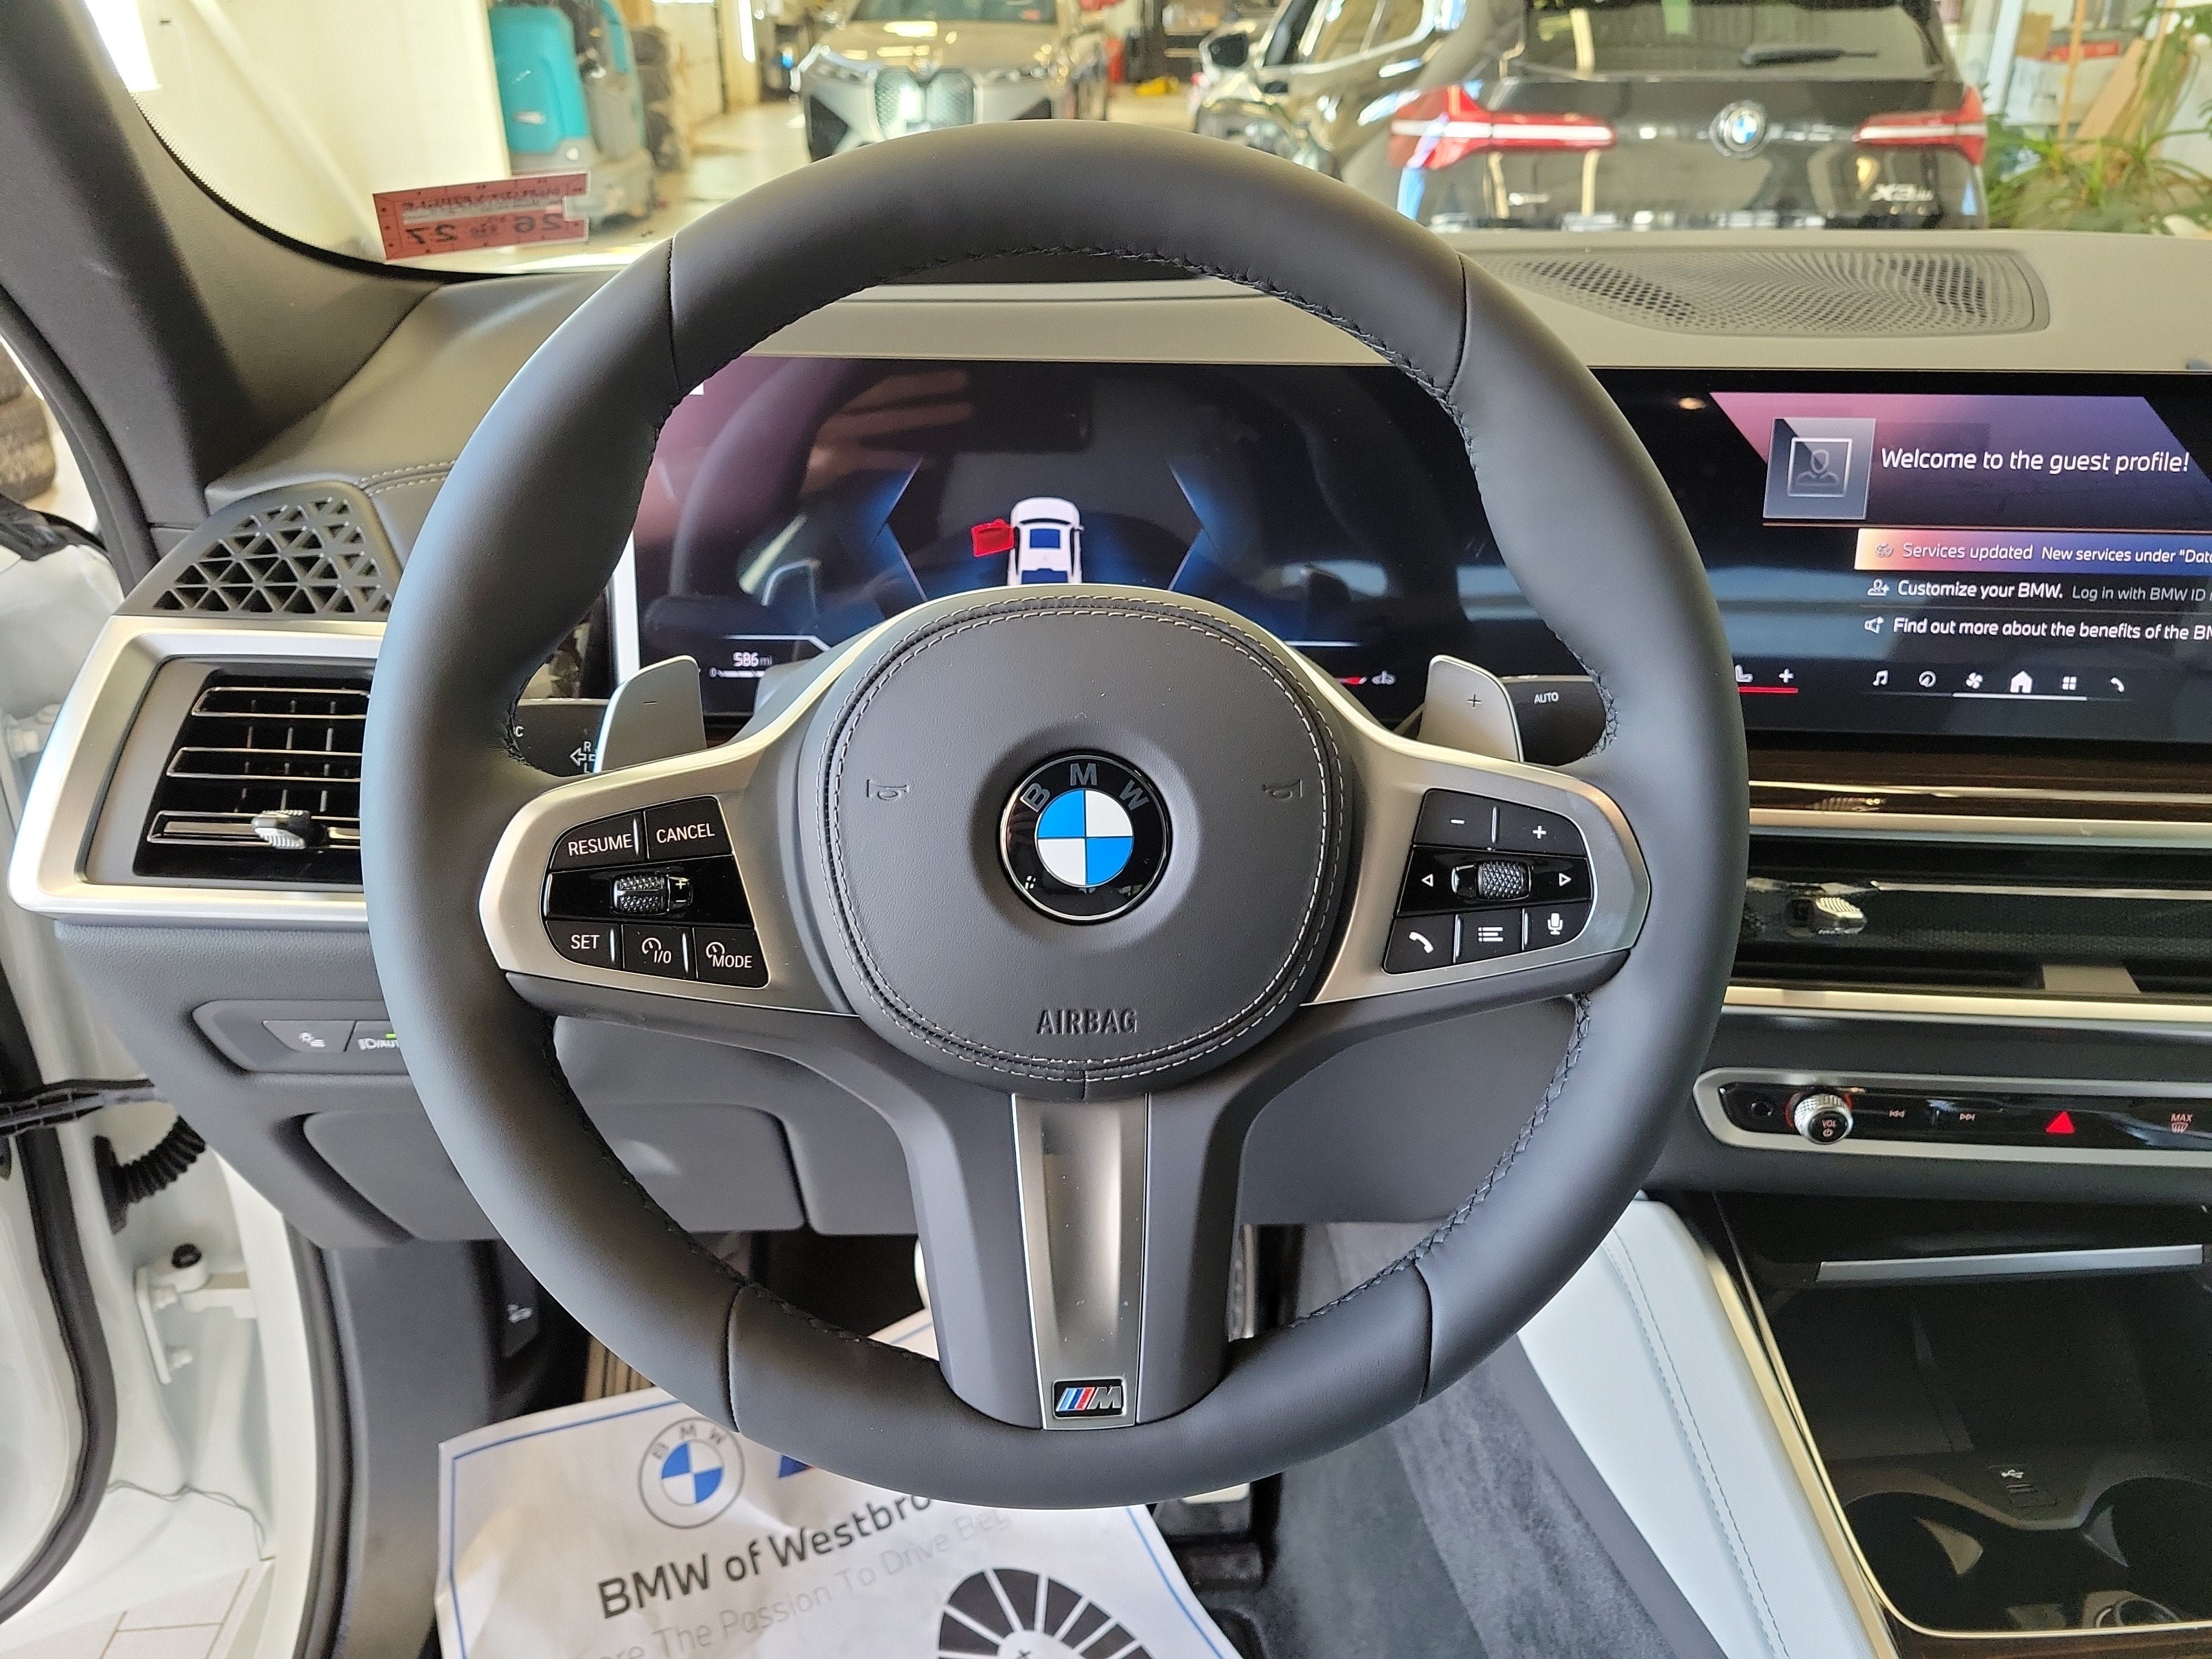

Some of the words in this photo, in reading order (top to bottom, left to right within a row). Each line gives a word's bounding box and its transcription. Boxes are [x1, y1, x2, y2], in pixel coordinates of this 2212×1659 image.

[1881, 448, 1977, 469] Welcome
[1983, 450, 2003, 470] to
[2009, 450, 2042, 471] the
[2050, 453, 2111, 475] guest
[2114, 452, 2190, 475] profile!
[1902, 542, 1966, 558] Services
[1970, 544, 2033, 561] updated
[2042, 546, 2073, 561] New
[2075, 548, 2132, 562] services
[2135, 549, 2176, 562] under
[1898, 579, 1977, 597] Customize
[1980, 585, 2015, 600] your
[2018, 582, 2063, 599] BMW.
[2072, 585, 2098, 602] Log
[2102, 586, 2114, 600] in
[2117, 586, 2146, 600] with
[2149, 587, 2188, 601] BMW
[2191, 588, 2206, 602] ID
[1893, 617, 1927, 634] Find
[1930, 620, 1956, 635] out
[1959, 622, 1999, 636] more
[2002, 620, 2048, 636] about
[2051, 620, 2075, 637] the
[2079, 622, 2141, 639] benefits
[2145, 624, 2162, 640] of
[2164, 624, 2189, 640] the
[733, 652, 759, 667] 586
[1534, 692, 1559, 704] AUTO
[583, 741, 591, 752] R
[1020, 763, 1149, 813] BMW
[568, 833, 633, 856] RESUME
[656, 823, 715, 844] CANCEL
[570, 934, 601, 950] SET
[712, 955, 753, 969] MODE
[1036, 1008, 1138, 1035] AIRBAG
[1821, 1119, 1837, 1128] VOL
[2171, 1113, 2193, 1122] MAX
[598, 1553, 710, 1620] BMW
[725, 1528, 761, 1582] of
[652, 1622, 713, 1659] The
[719, 1584, 832, 1640] Passion
[834, 1565, 877, 1593] To
[880, 1532, 950, 1576] Drive
